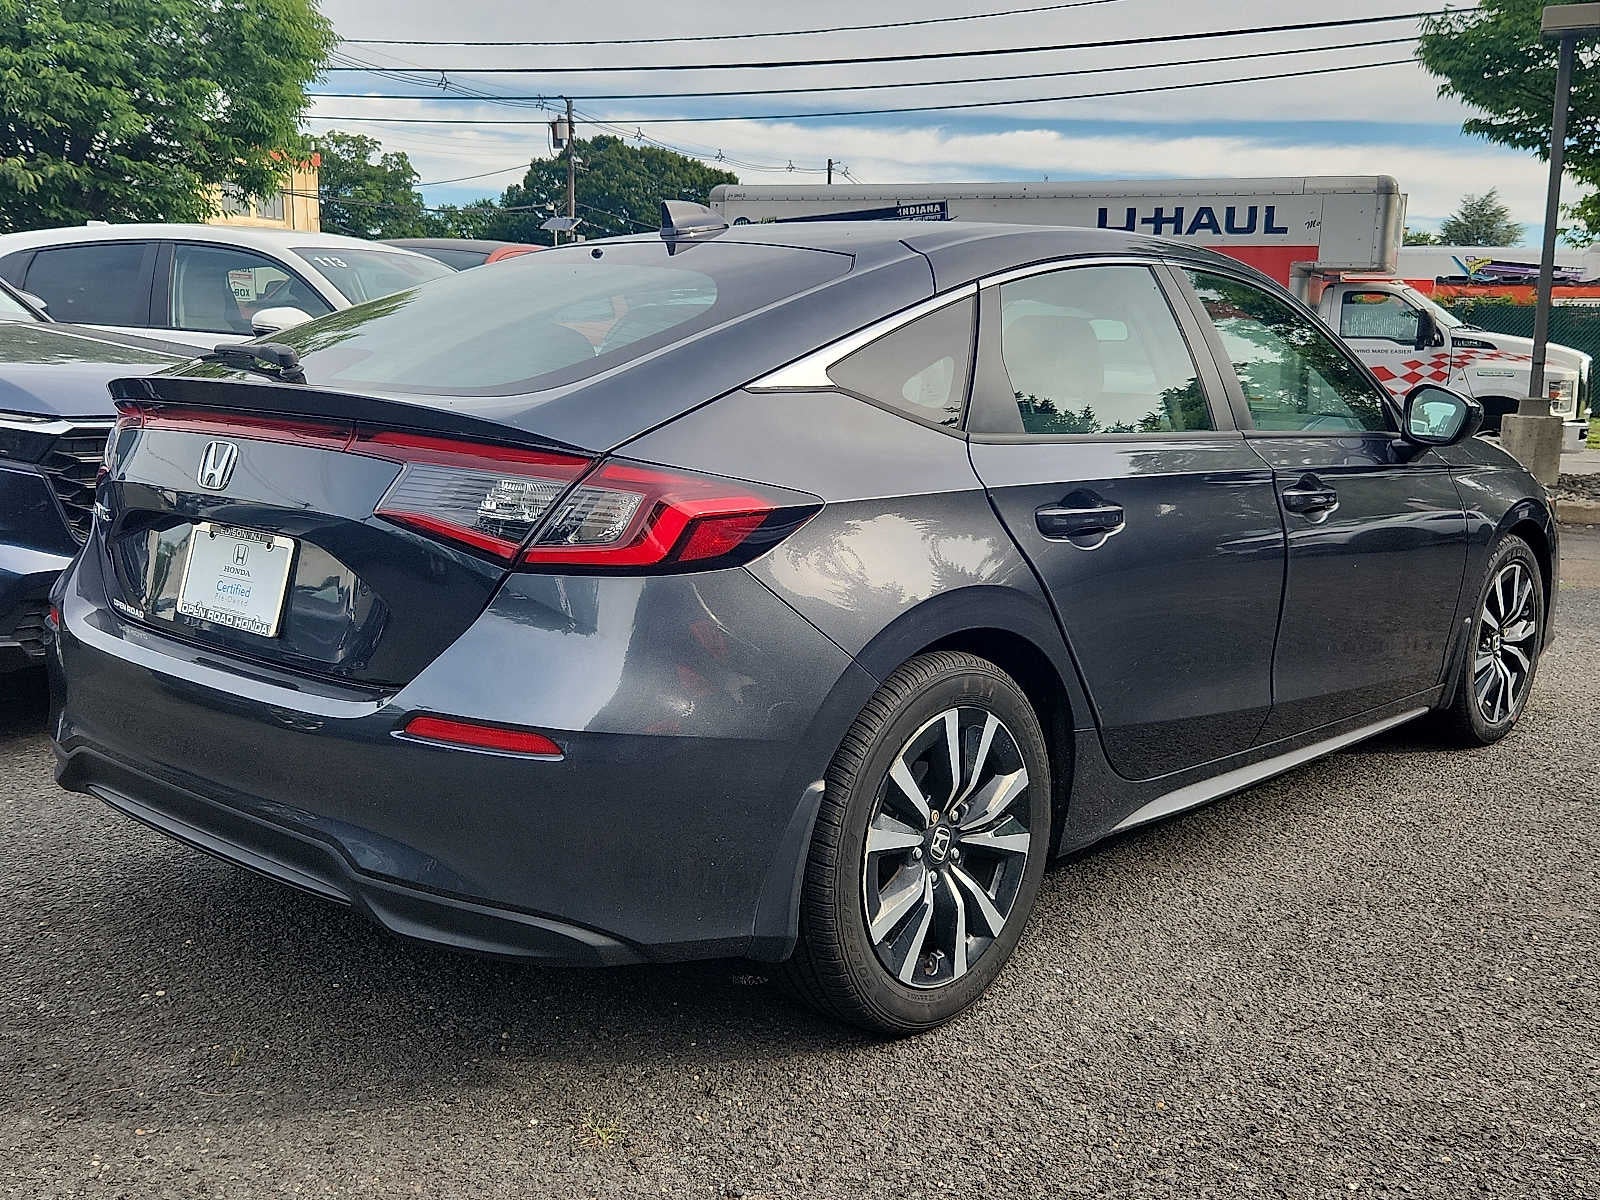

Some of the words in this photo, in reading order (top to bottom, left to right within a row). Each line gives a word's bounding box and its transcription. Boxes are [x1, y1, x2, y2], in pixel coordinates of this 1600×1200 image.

[898, 204, 941, 217] INDIANA
[1096, 205, 1289, 236] U-HAUL
[313, 255, 348, 269] 113
[223, 565, 252, 578] HONDA
[215, 579, 253, 599] Certified
[113, 598, 127, 611] OPEN
[126, 603, 145, 619] ROAD
[181, 602, 207, 619] OPEN
[206, 608, 234, 626] ROAD
[234, 616, 269, 637] HONDA
